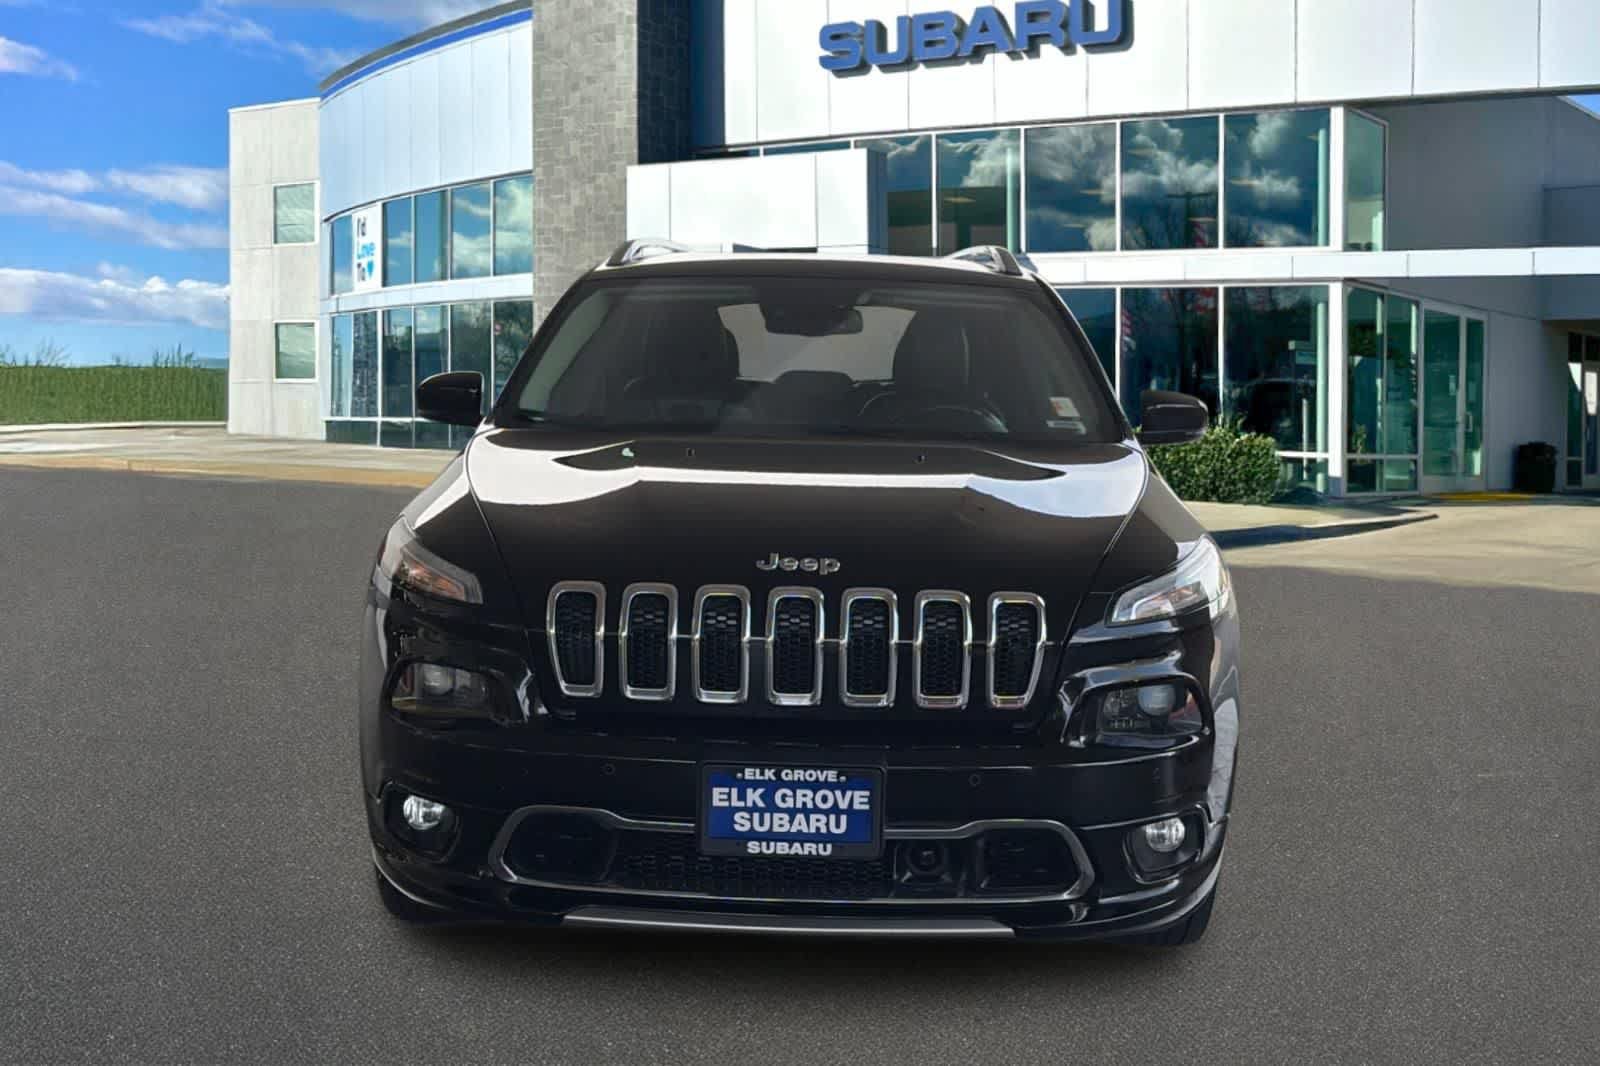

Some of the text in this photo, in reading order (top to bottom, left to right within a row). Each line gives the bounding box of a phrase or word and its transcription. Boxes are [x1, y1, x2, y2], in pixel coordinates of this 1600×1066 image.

[819, 0, 1130, 75] SUBARU
[756, 552, 840, 575] Jeep
[744, 768, 838, 782] ELK GROVE
[712, 787, 870, 810] ELK GROVE
[733, 811, 847, 834] SUBARU
[746, 841, 832, 856] SUBARU
